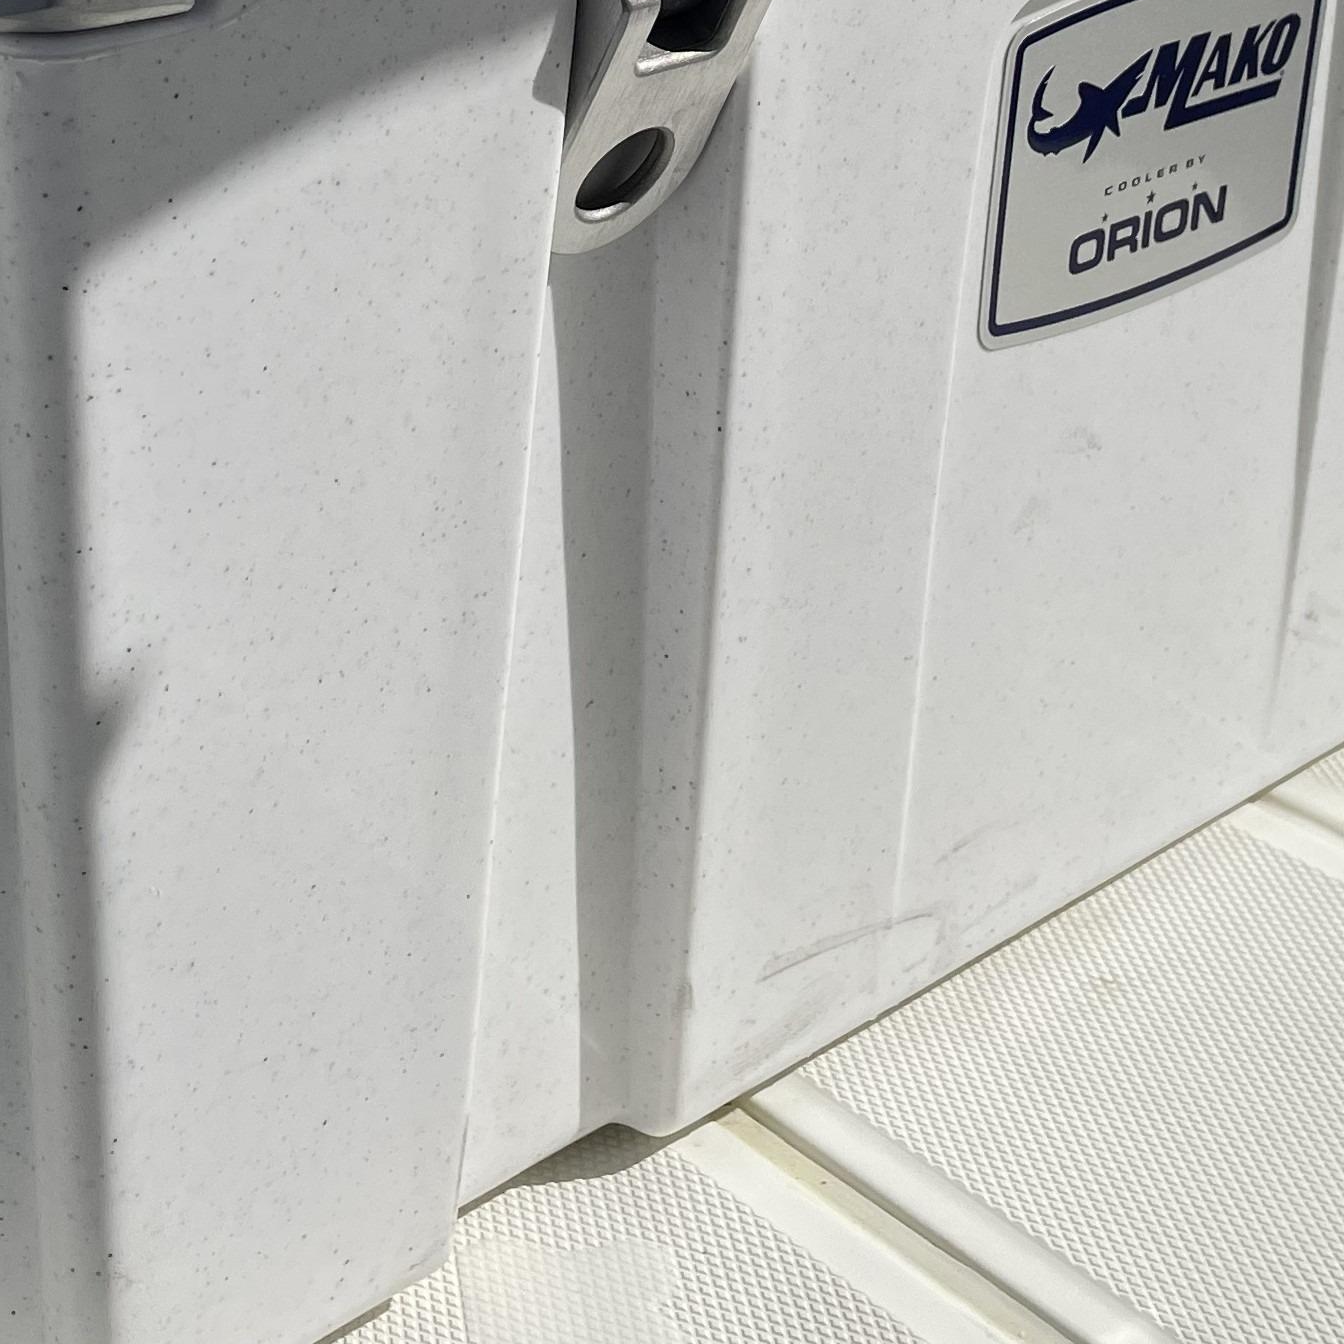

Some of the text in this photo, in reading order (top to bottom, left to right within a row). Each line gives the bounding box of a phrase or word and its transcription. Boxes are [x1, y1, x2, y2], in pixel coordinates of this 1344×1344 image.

[1122, 13, 1301, 130] MAKO
[1104, 154, 1206, 196] COOLER BY
[1068, 185, 1228, 275] ORION
